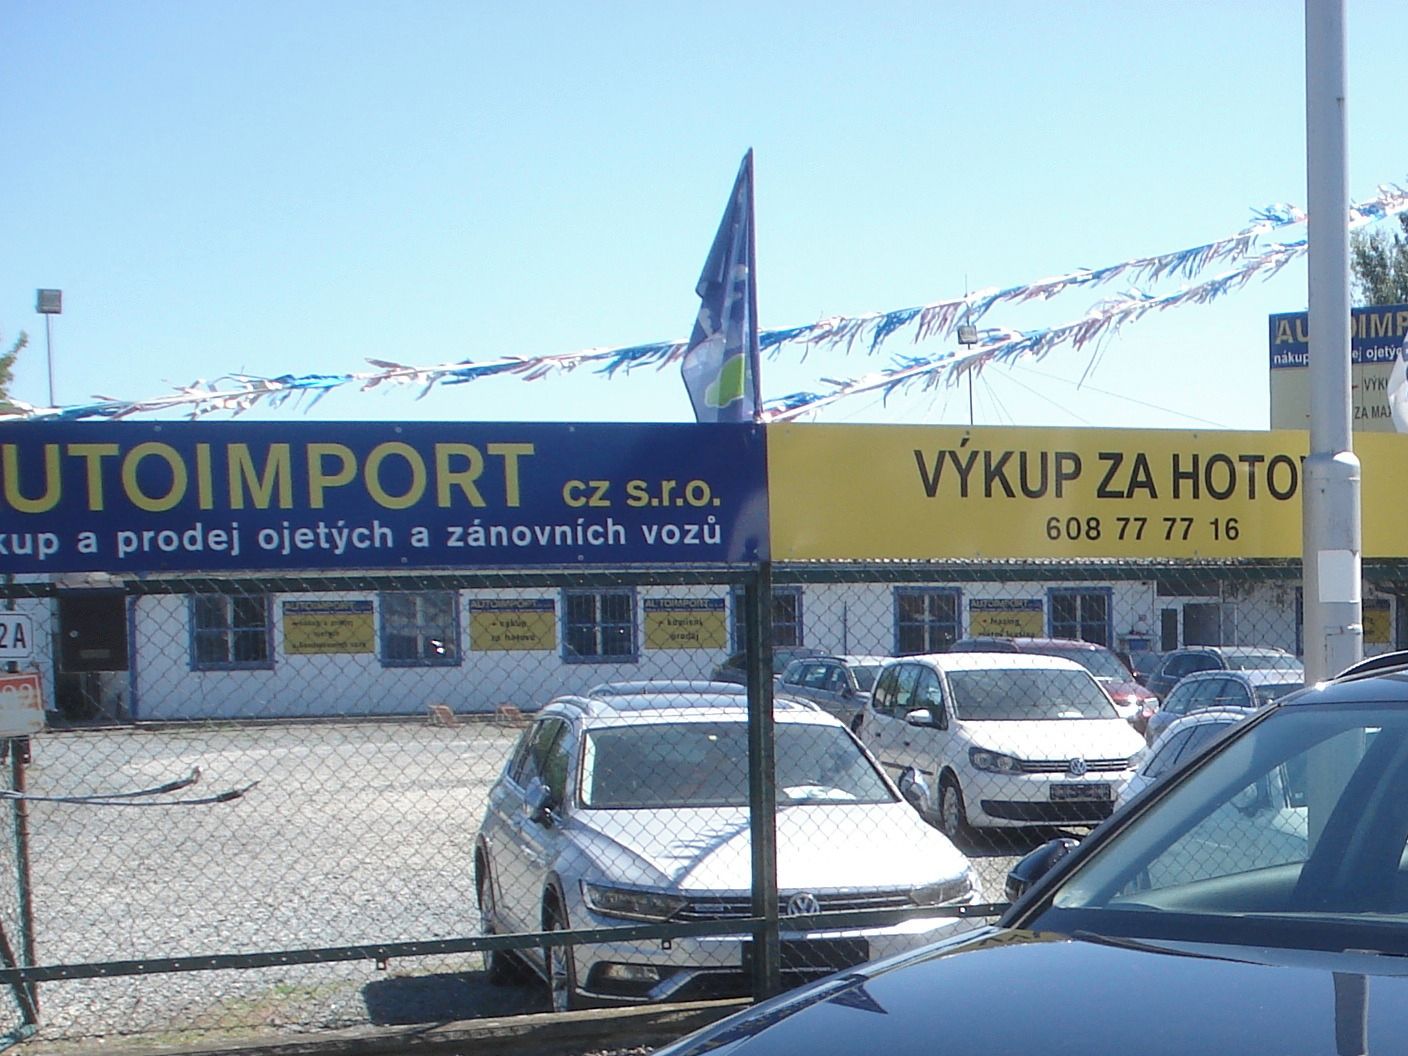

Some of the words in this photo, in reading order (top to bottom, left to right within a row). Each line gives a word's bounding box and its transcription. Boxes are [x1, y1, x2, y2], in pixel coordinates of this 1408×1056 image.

[2, 442, 535, 513] UTOIMPORT
[562, 478, 611, 508] cz
[626, 477, 722, 507] s.r.o.
[912, 438, 1083, 498] VÝKUP
[1096, 452, 1159, 499] ZA
[1172, 454, 1306, 500] HOTO
[78, 531, 98, 553] a
[117, 522, 241, 558] prodej
[258, 519, 394, 555] ojetých
[410, 523, 430, 548] a
[447, 516, 629, 548] zánovních
[643, 513, 723, 545] vozů
[1046, 517, 1101, 541] 608
[1115, 517, 1148, 541] 77
[1162, 517, 1194, 541] 77
[1209, 517, 1240, 541] 16
